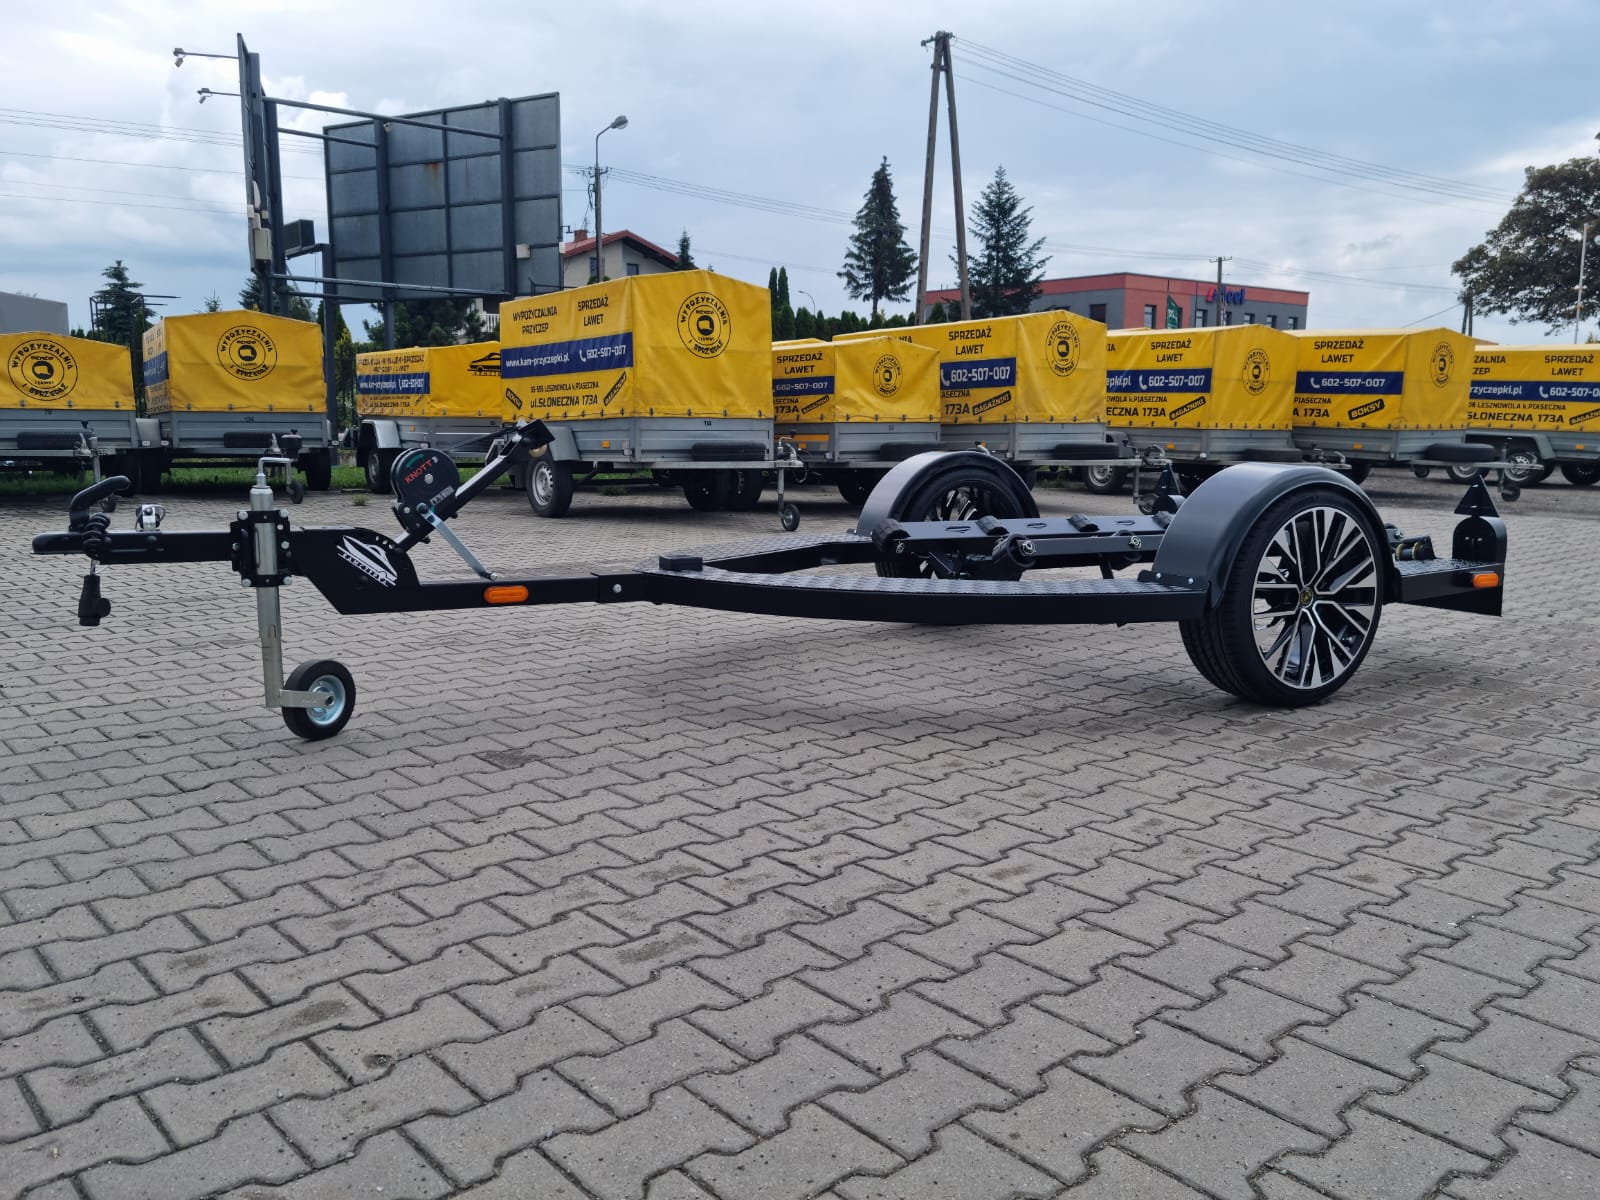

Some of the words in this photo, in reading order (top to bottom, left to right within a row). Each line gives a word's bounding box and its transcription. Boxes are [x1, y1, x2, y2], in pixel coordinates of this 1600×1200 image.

[577, 294, 609, 311] SPRZEDAŻ
[512, 304, 558, 321] WYPOŻYCZALNIA
[583, 313, 604, 326] LAWET
[522, 322, 549, 335] PRZYCZEP
[948, 326, 992, 341] SPRZEDAŻ
[955, 344, 984, 355] LAWET
[1151, 338, 1192, 350] SPRZEDAŻ
[1314, 339, 1364, 350] SPRZEDAŻ
[505, 353, 570, 368] www.kam-przyczepki.pl
[586, 345, 626, 359] 602-507-007
[776, 351, 823, 364] SPRZEDAŻ
[1156, 353, 1183, 362] LAWET
[1321, 354, 1354, 363] LAWET
[1544, 353, 1594, 364] SPRZEDAŻ
[784, 365, 815, 375] LAWET
[951, 366, 1010, 383] 602-507-007
[1551, 367, 1584, 376] LAWET
[776, 381, 828, 391] 602-507-007
[1148, 375, 1205, 387] 602-507-007
[1321, 378, 1386, 388] 602-507-007
[941, 389, 971, 399] ASECZNA
[1469, 385, 1522, 396] rzyczepki.pl
[1549, 386, 1600, 398] 602-507-0
[582, 394, 598, 406] 173A
[775, 405, 799, 414] 173A
[945, 403, 970, 415] 173A
[1142, 407, 1166, 417] 173A
[1304, 408, 1330, 417] 173A
[1350, 400, 1383, 419] BOKSY
[1467, 412, 1533, 422] SŁONECZNA
[1538, 414, 1564, 424] 173A
[404, 459, 433, 484] KNOTT
